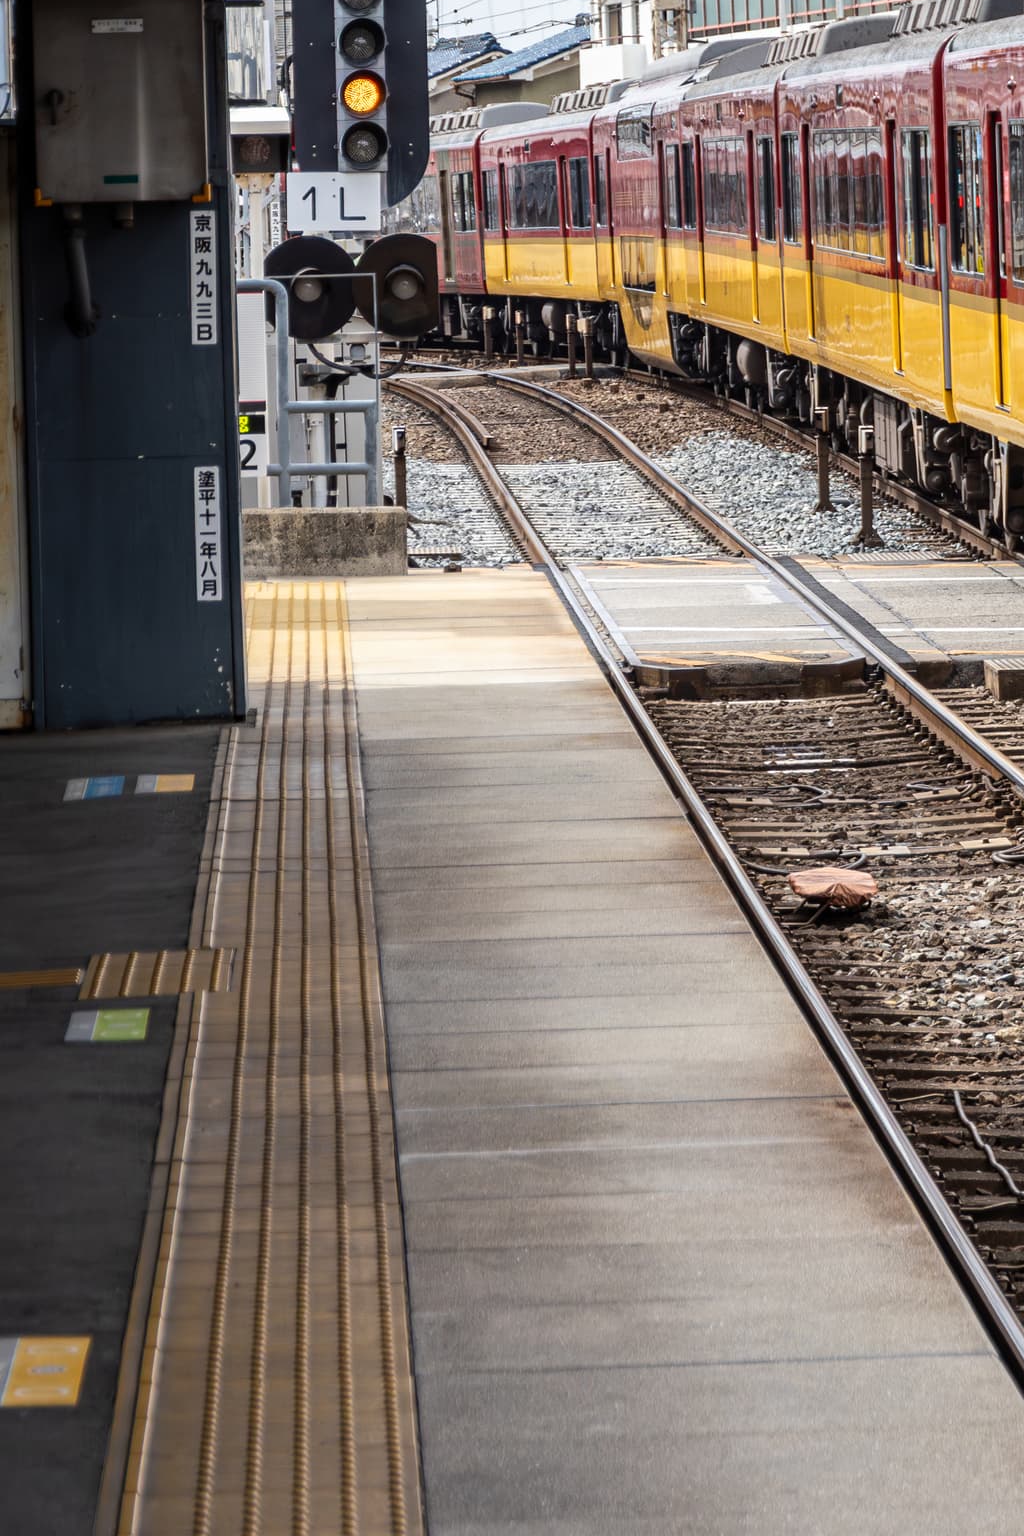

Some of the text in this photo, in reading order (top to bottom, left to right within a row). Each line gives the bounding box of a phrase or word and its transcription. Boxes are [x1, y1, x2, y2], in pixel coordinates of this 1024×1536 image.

[194, 214, 213, 341] 京阪九九三B
[198, 470, 217, 597] 塗平十一年八月
